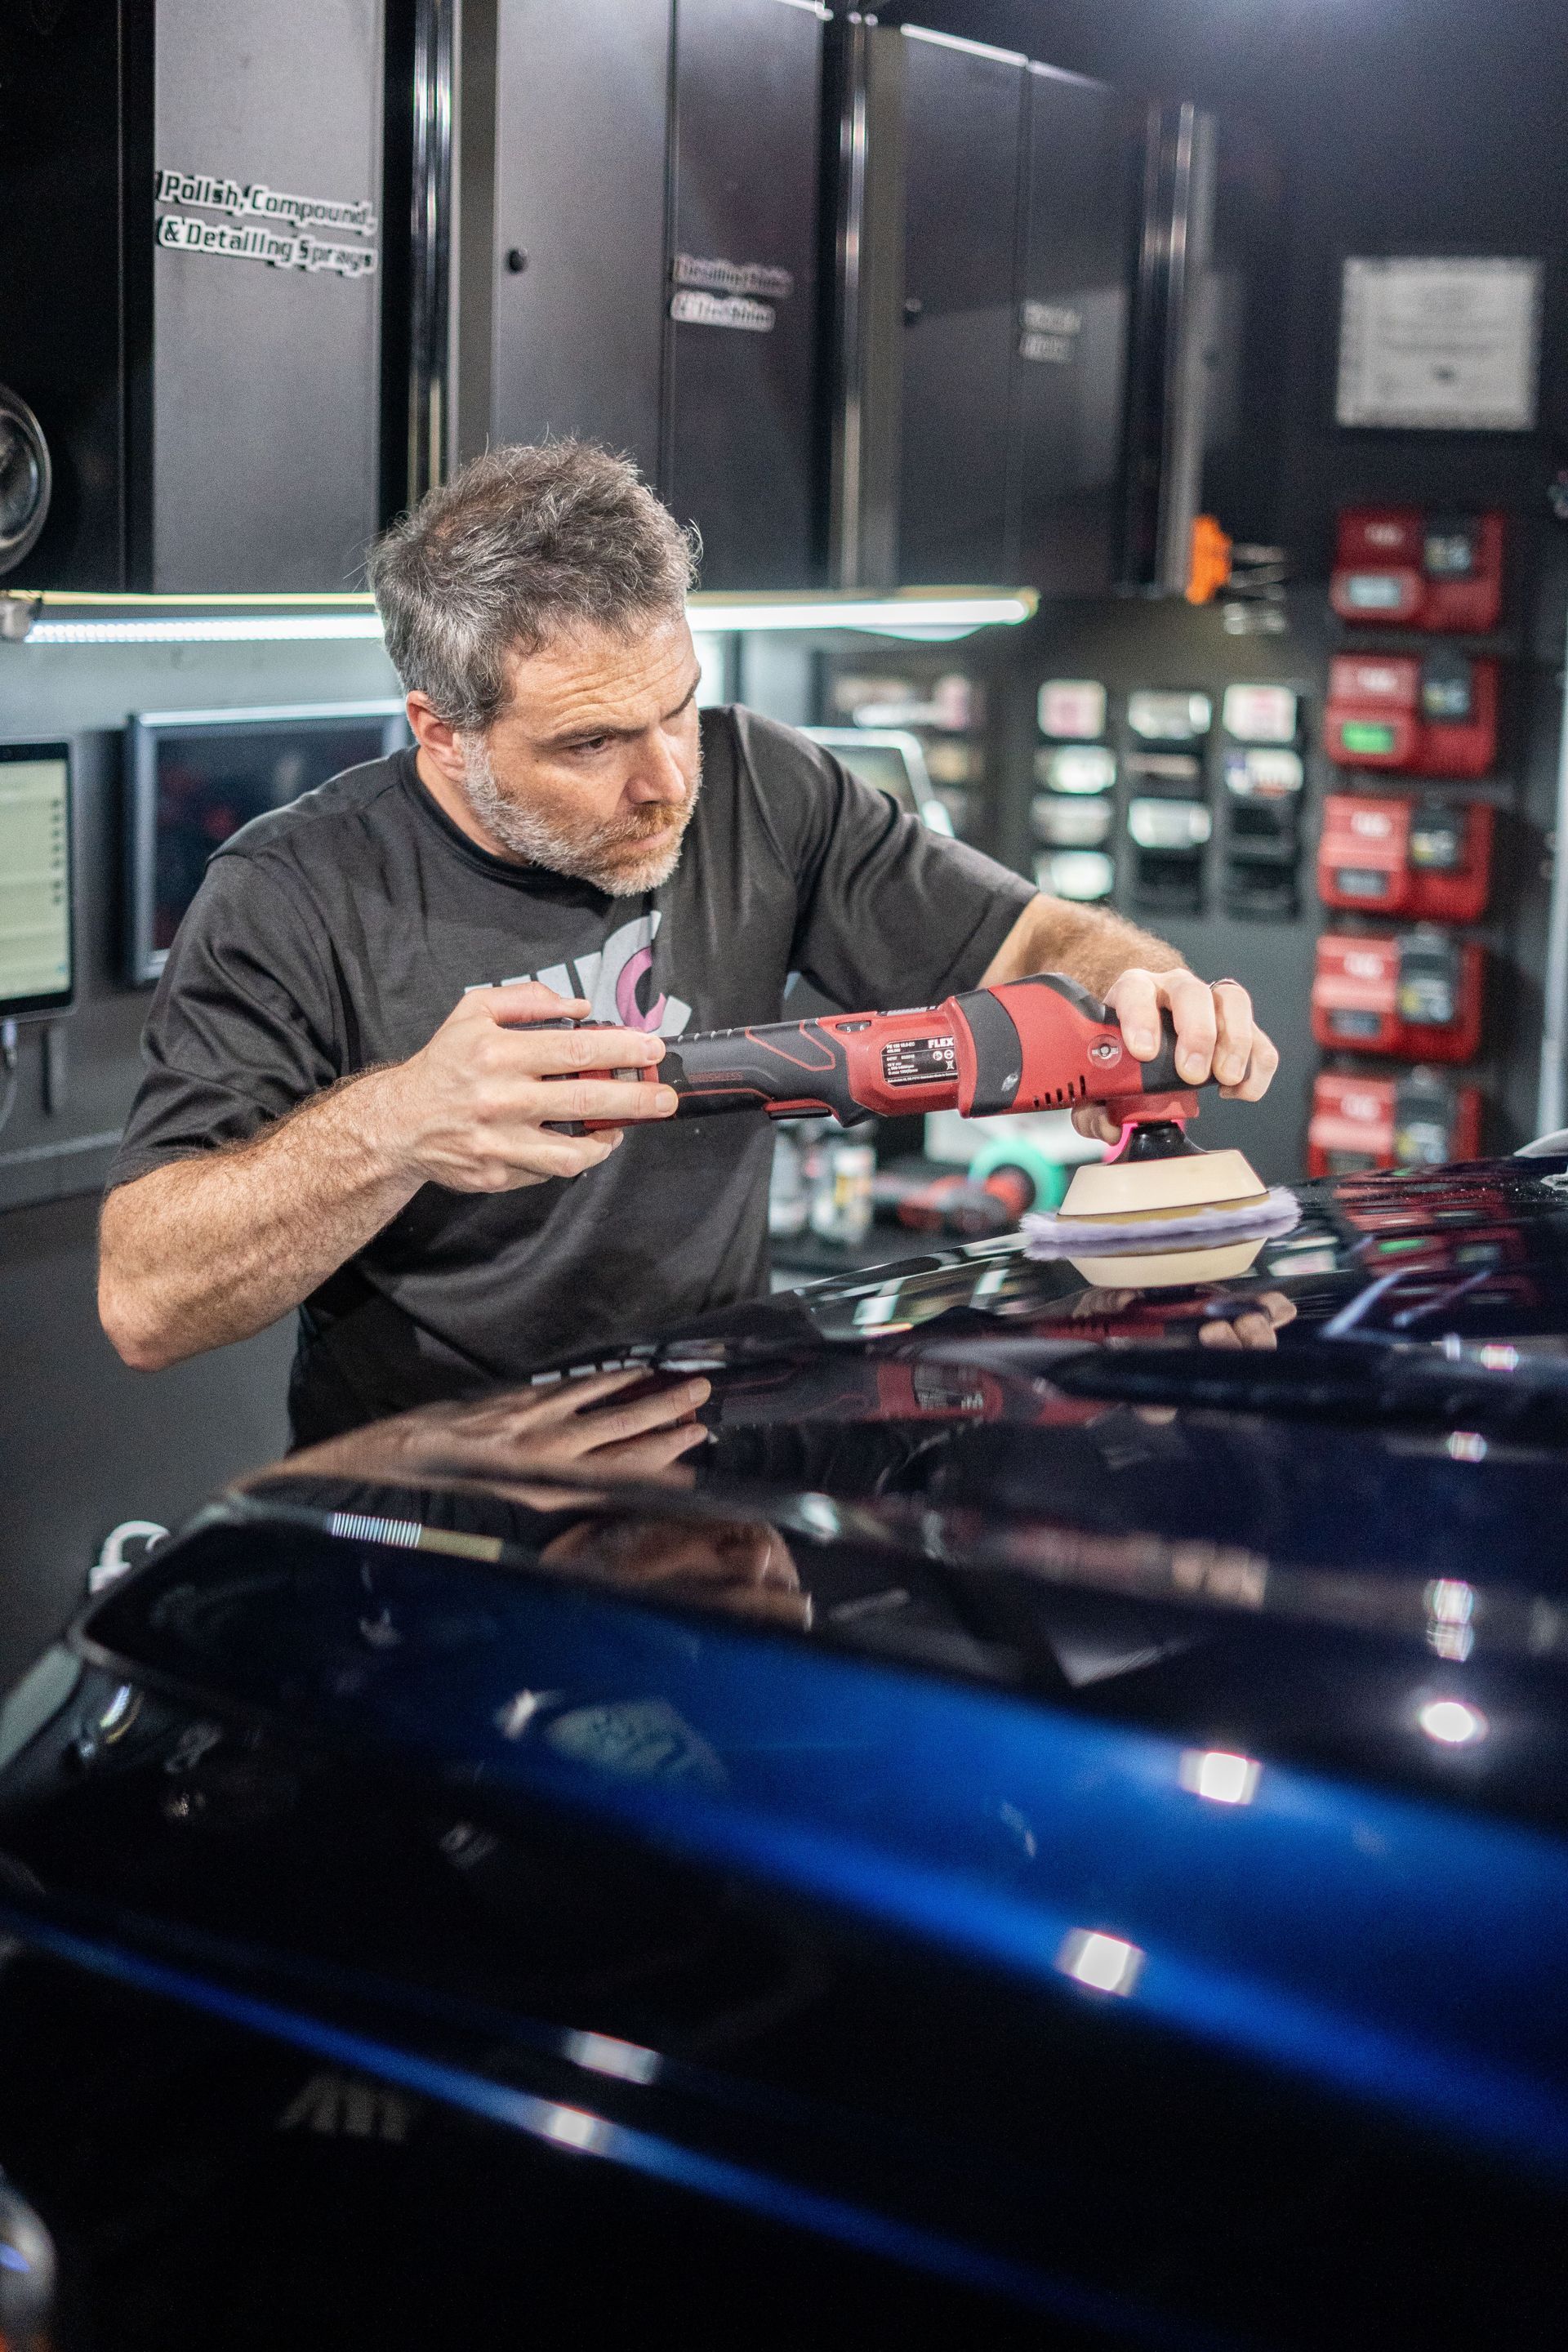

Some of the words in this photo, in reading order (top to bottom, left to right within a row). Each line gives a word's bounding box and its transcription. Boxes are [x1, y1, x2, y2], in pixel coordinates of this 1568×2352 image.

[163, 172, 245, 212] Polish,
[163, 219, 180, 243] &
[185, 222, 294, 263] Detailing
[298, 238, 373, 272] Sprays
[928, 1037, 954, 1049] FLEX
